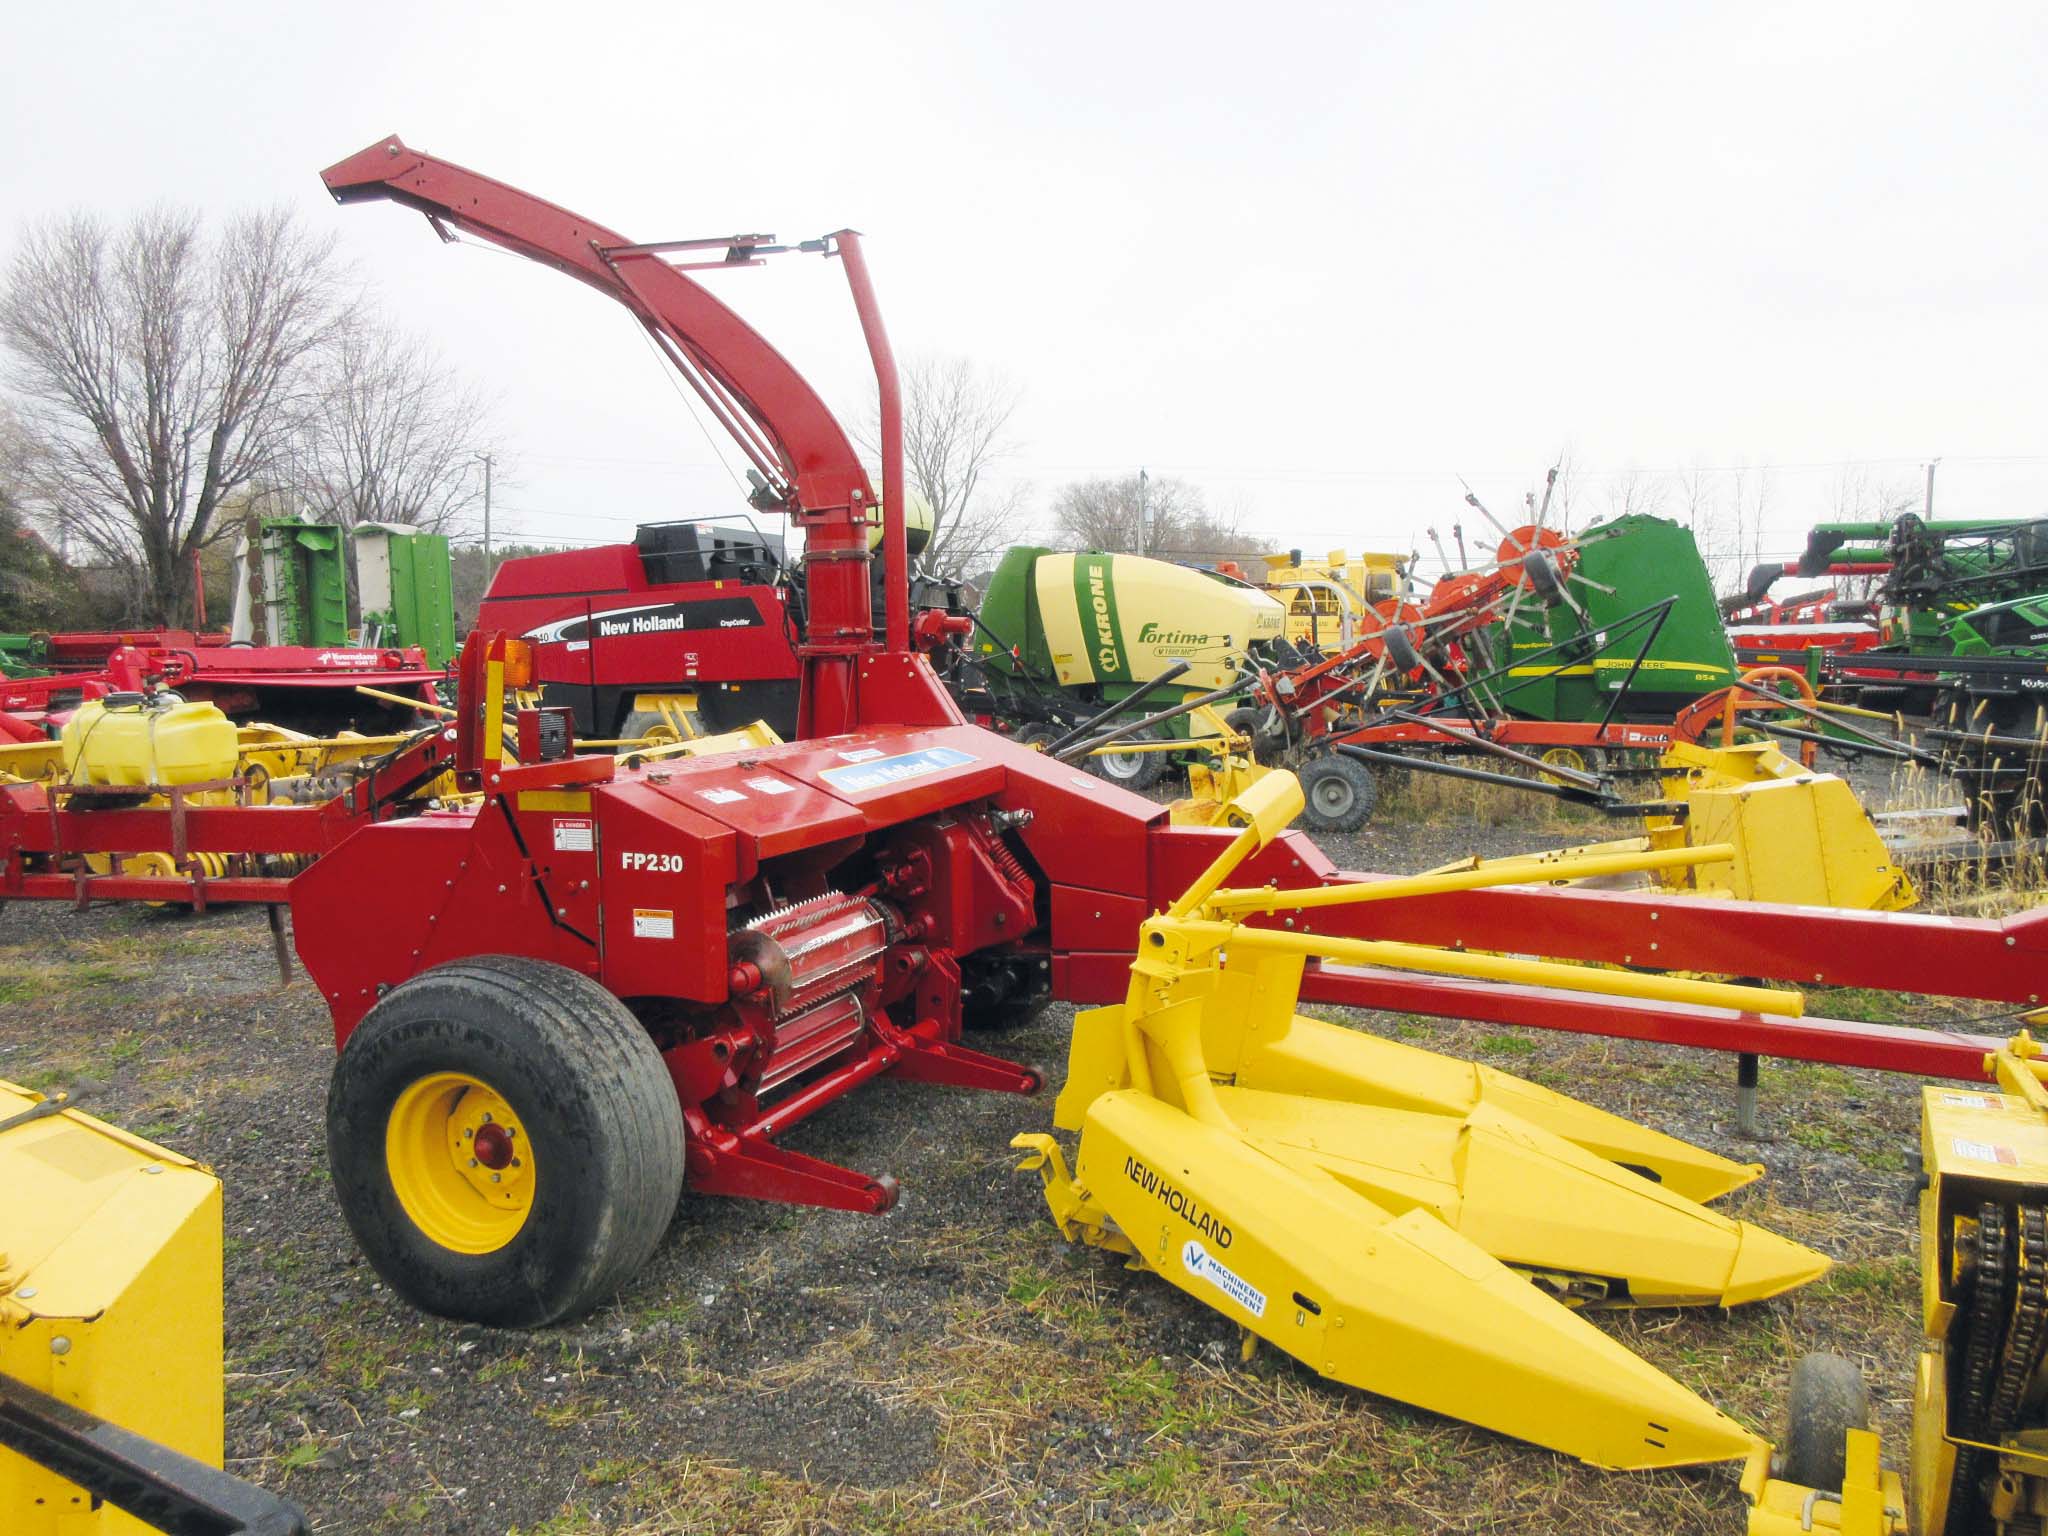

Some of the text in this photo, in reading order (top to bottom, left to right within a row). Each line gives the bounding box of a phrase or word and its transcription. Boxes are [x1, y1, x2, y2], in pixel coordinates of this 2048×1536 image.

[1089, 565, 1114, 646] KRONE
[601, 613, 684, 636] New Holland
[1138, 622, 1208, 644] Fortima
[1606, 660, 1632, 669] JOHN
[1695, 673, 1716, 681] 854
[622, 852, 683, 872] FP230
[1124, 1156, 1233, 1249] NEW HOLLAND
[1208, 1259, 1264, 1305] MACHINERIE
[1223, 1280, 1262, 1313] VINCENT
